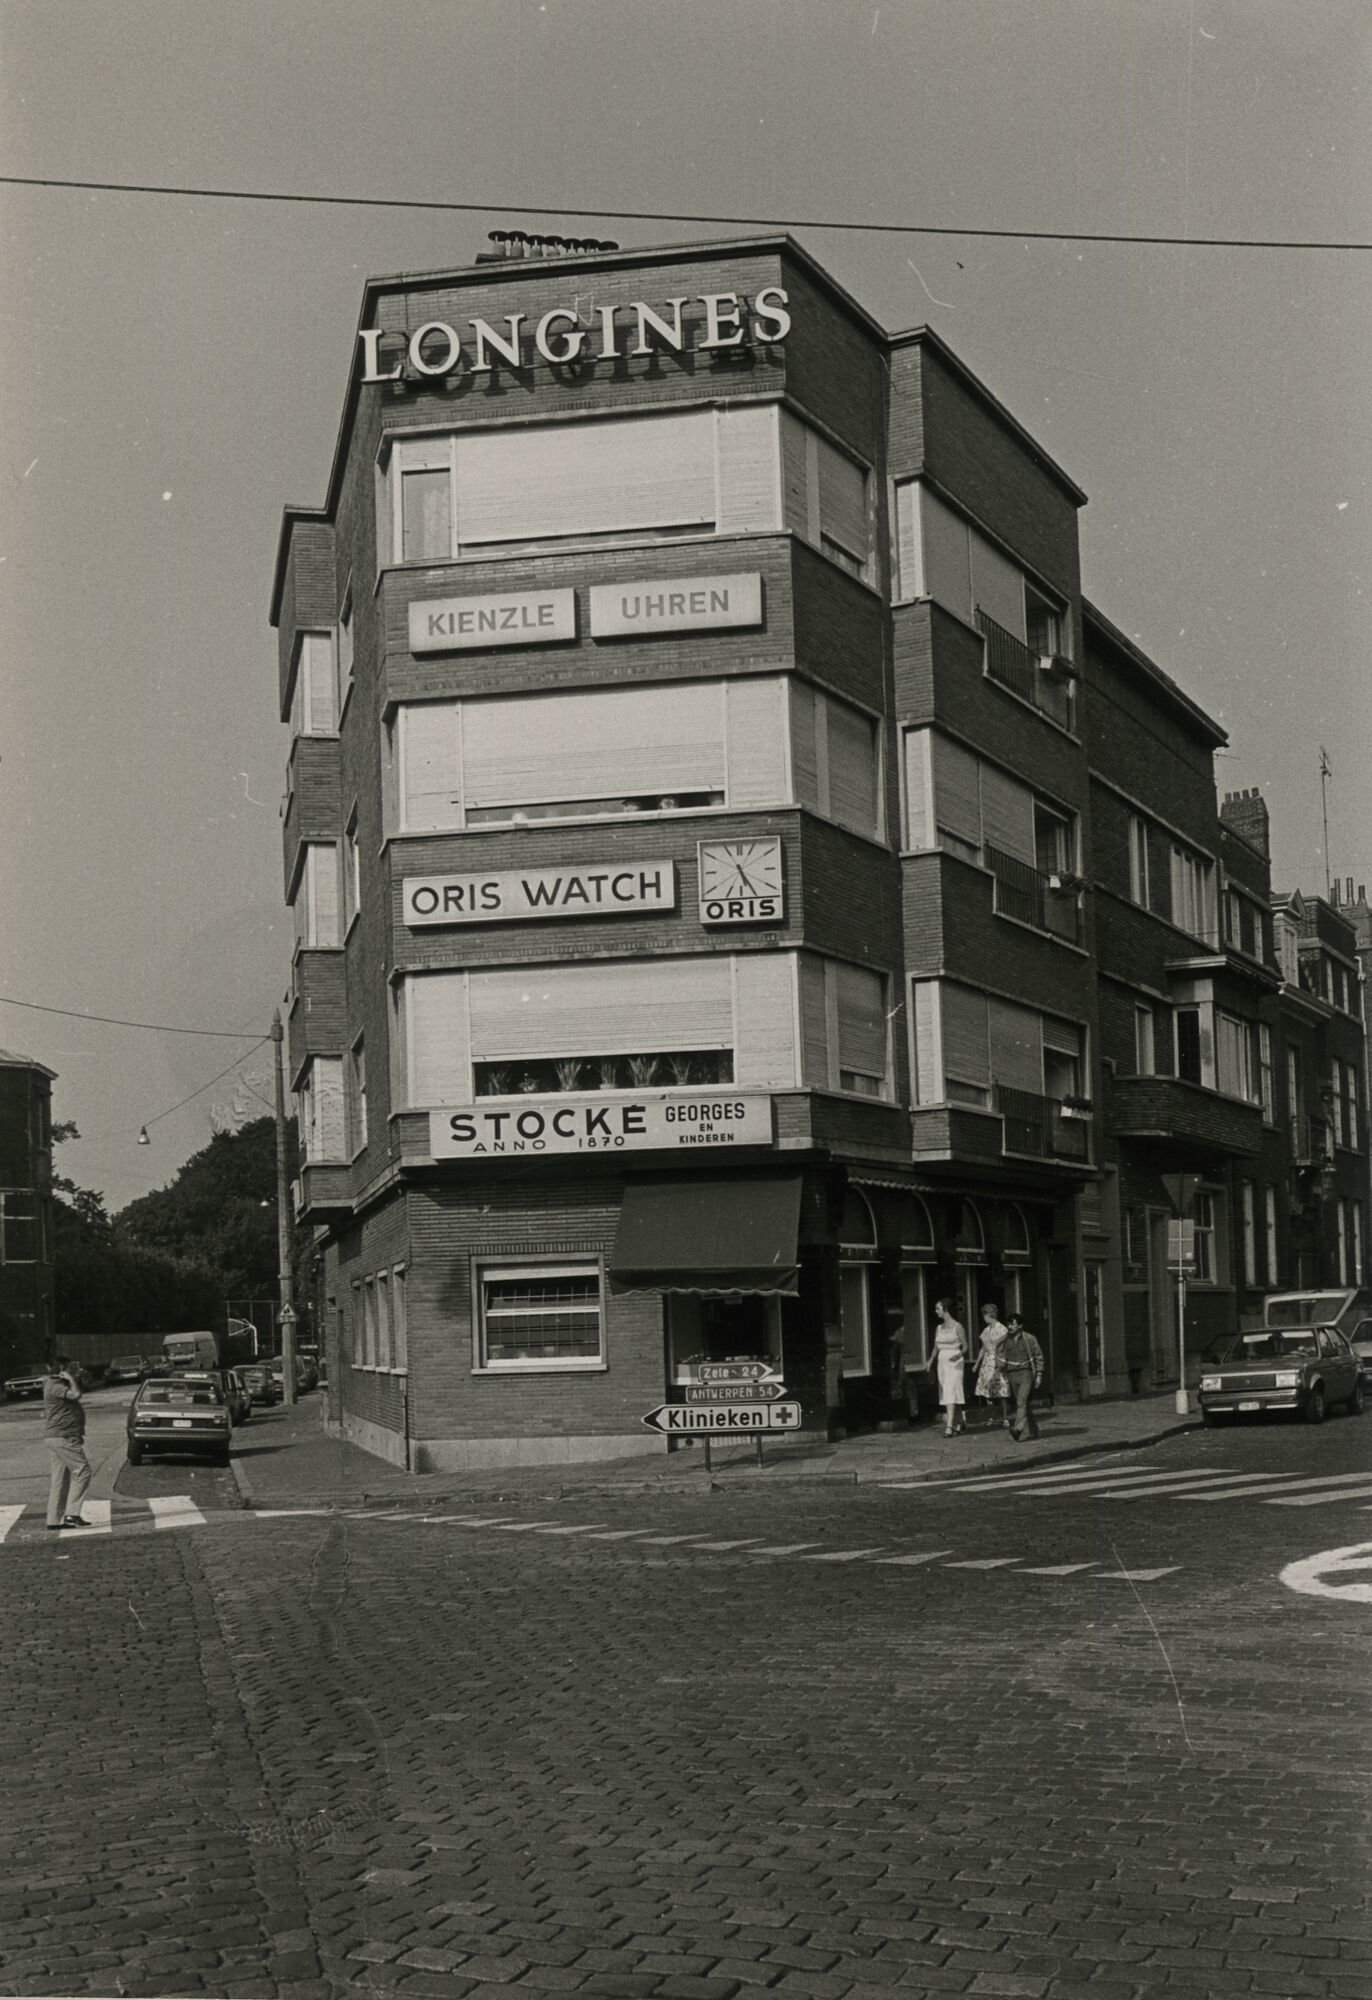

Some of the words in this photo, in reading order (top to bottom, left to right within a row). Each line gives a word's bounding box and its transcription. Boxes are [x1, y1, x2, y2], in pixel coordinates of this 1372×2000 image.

[359, 286, 792, 383] LONGINES
[621, 589, 730, 619] UHREN
[428, 604, 555, 636] KIENZLE
[411, 882, 502, 915] ORIS
[521, 871, 662, 907] WATCH
[706, 899, 776, 920] ORIS
[665, 1103, 746, 1123] GEORGES
[699, 1123, 714, 1132] EN
[473, 1139, 546, 1153] ANNO
[578, 1136, 625, 1148] 1870
[679, 1133, 734, 1144] KINDEREN
[704, 1368, 729, 1378] Zele
[742, 1367, 758, 1377] 24
[692, 1387, 753, 1400] ANTWERPEN
[759, 1386, 773, 1396] 54
[669, 1409, 763, 1428] Klinieken
